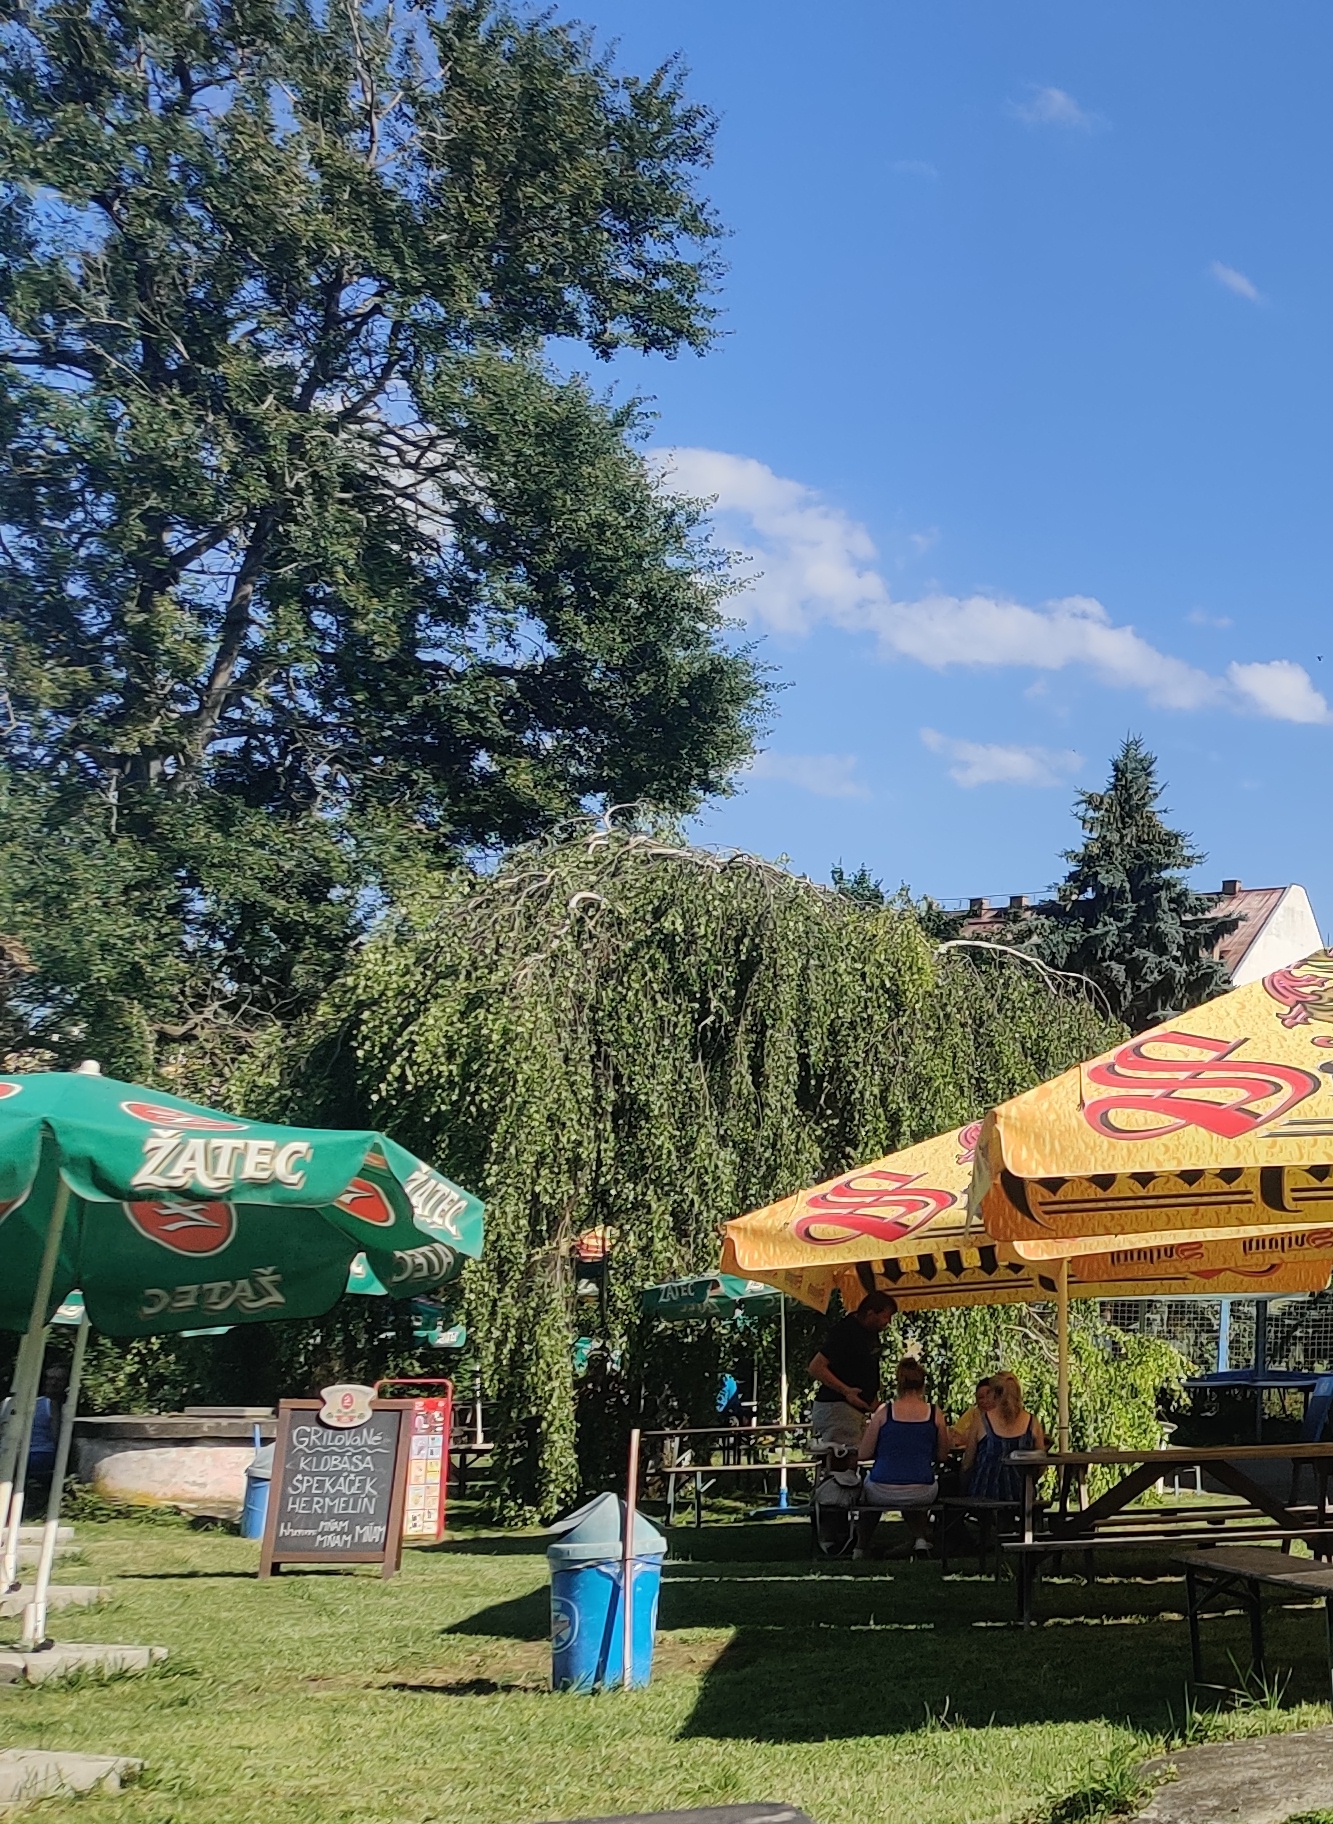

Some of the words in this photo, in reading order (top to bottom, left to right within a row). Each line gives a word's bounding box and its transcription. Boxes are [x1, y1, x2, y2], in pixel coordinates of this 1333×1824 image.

[130, 1128, 313, 1193] ŽATEC
[403, 1162, 464, 1241] ŽATEC
[299, 1452, 375, 1471] KLOBÁSA
[288, 1472, 378, 1496] ŠPEKÁČEK
